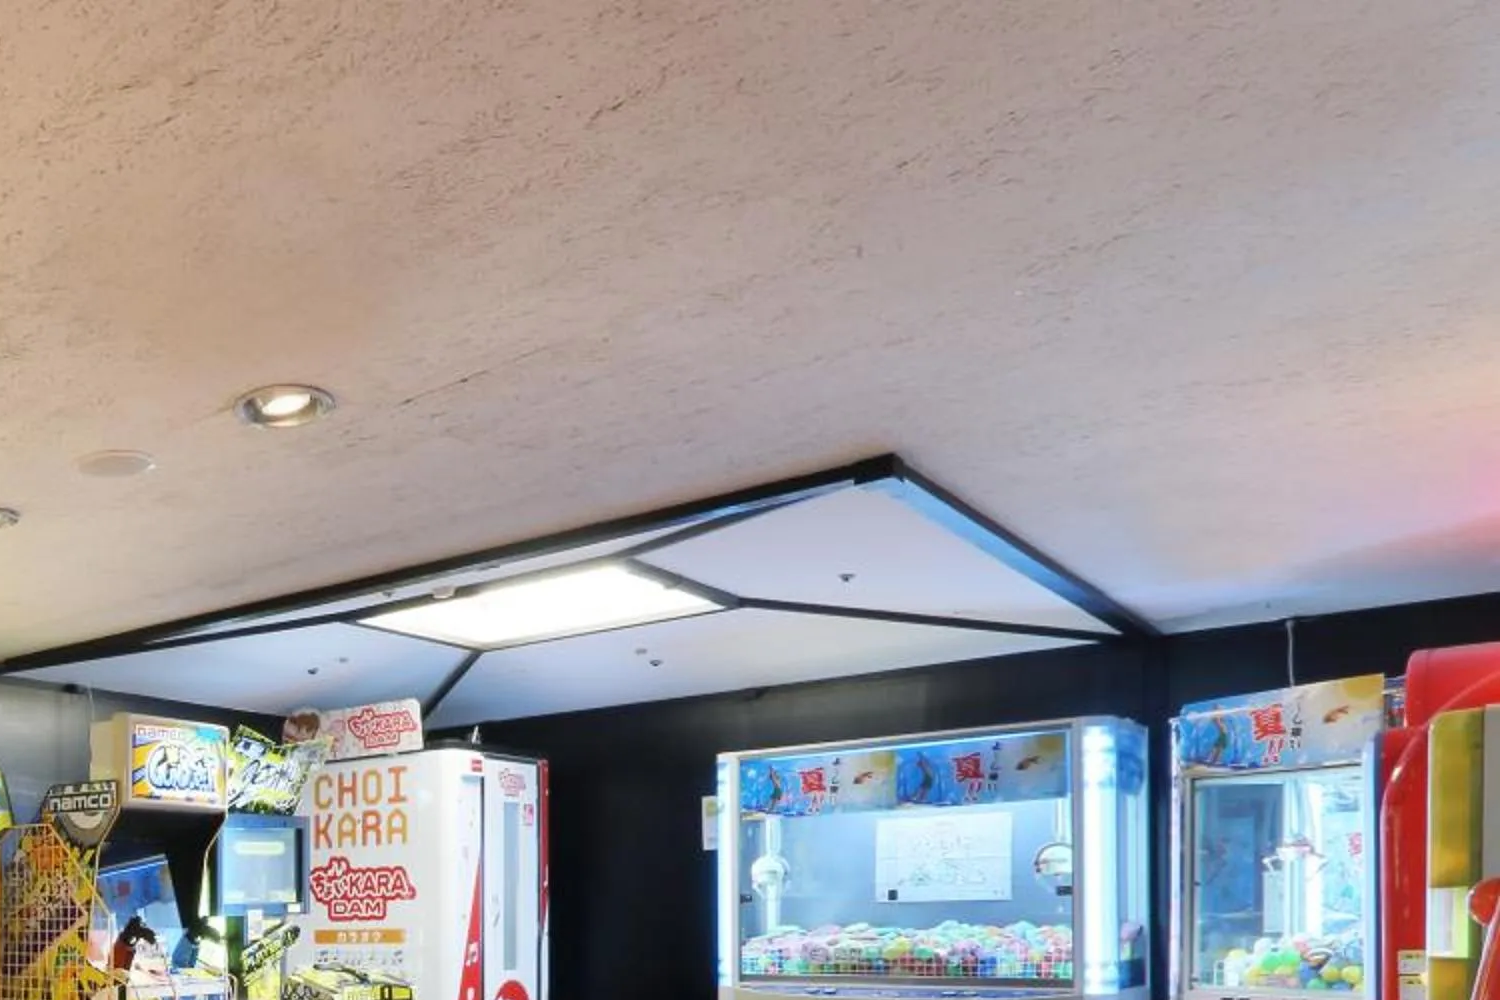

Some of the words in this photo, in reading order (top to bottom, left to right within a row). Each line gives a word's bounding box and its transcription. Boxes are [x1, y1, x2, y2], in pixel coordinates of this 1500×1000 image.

[314, 766, 407, 810] CHOI
[49, 794, 111, 811] namco
[314, 810, 407, 848] KARA
[333, 900, 381, 915] DAM
